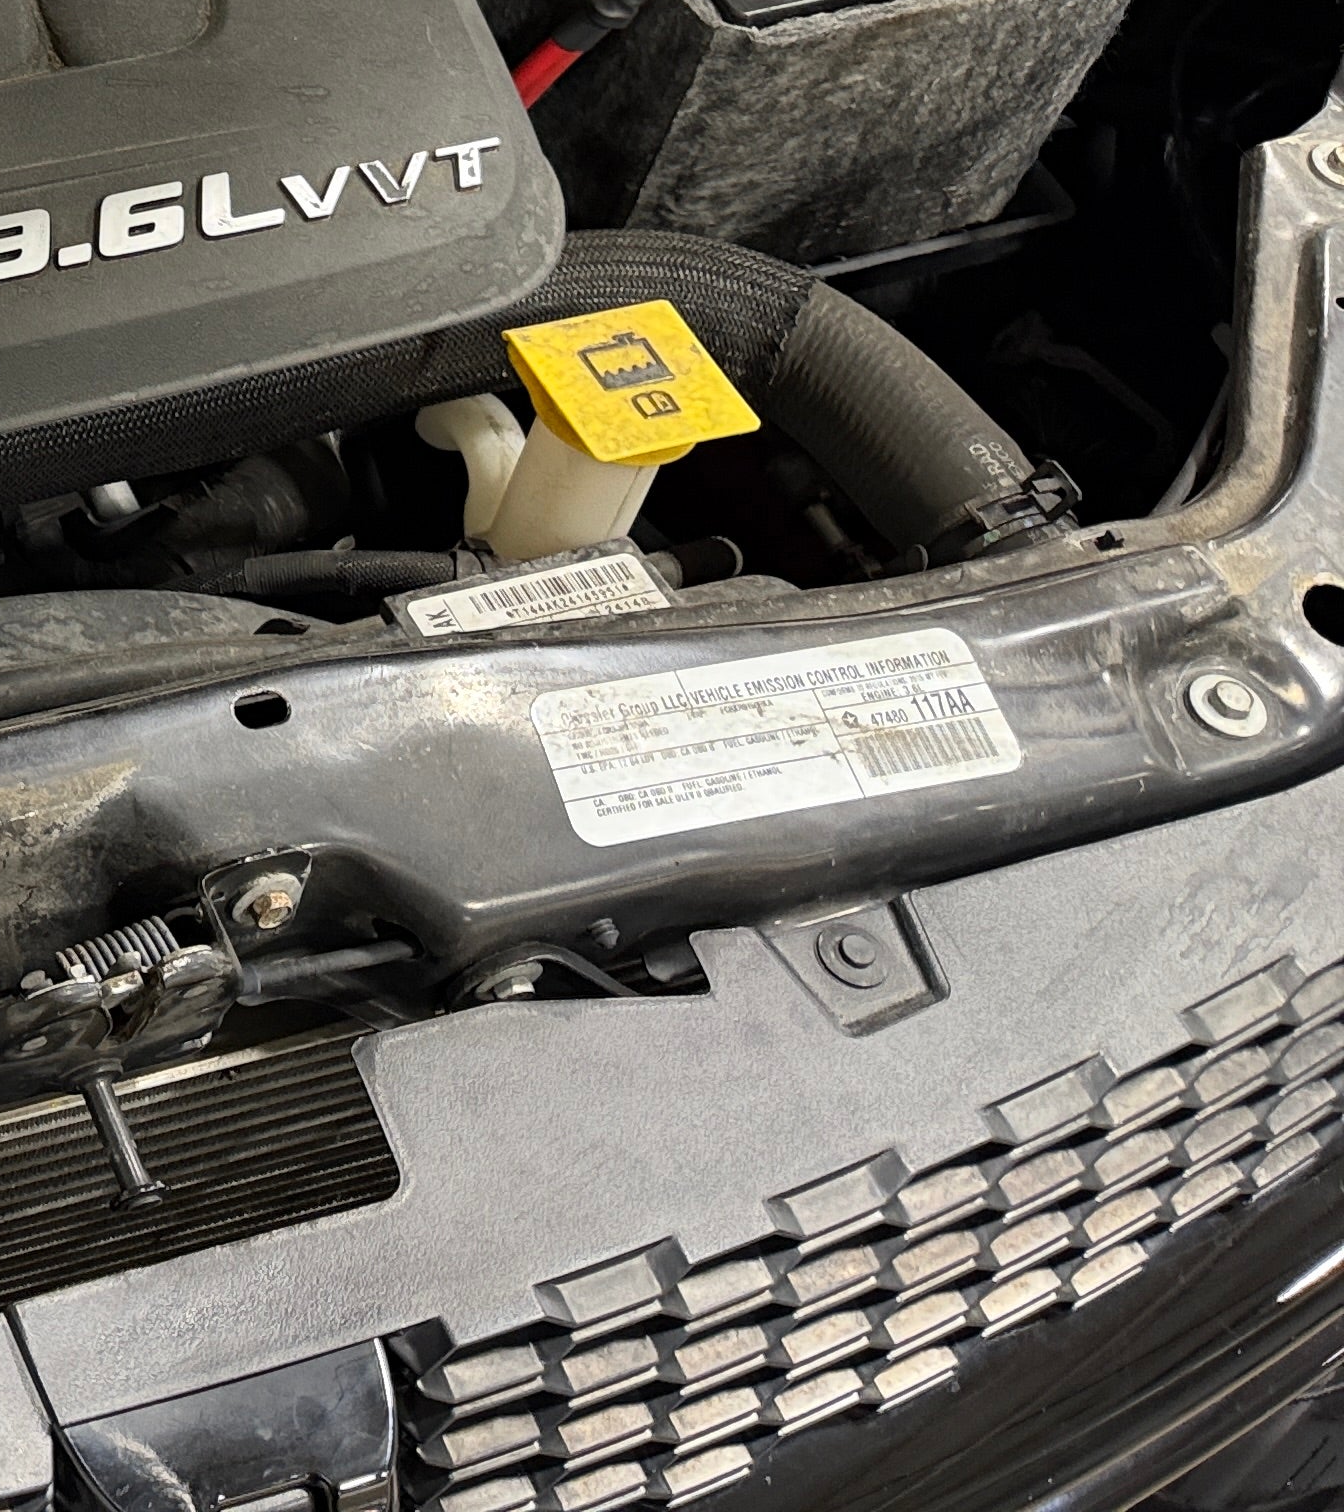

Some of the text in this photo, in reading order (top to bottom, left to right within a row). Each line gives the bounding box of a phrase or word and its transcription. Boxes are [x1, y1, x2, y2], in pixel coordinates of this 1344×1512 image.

[424, 608, 457, 629] AK
[689, 651, 950, 705] VEHICLE EMISSION CONTROL INFORMATION
[618, 701, 659, 721] Group
[660, 693, 688, 710] LLC
[871, 687, 975, 726] 47480 117AA
[637, 799, 654, 809] FOR
